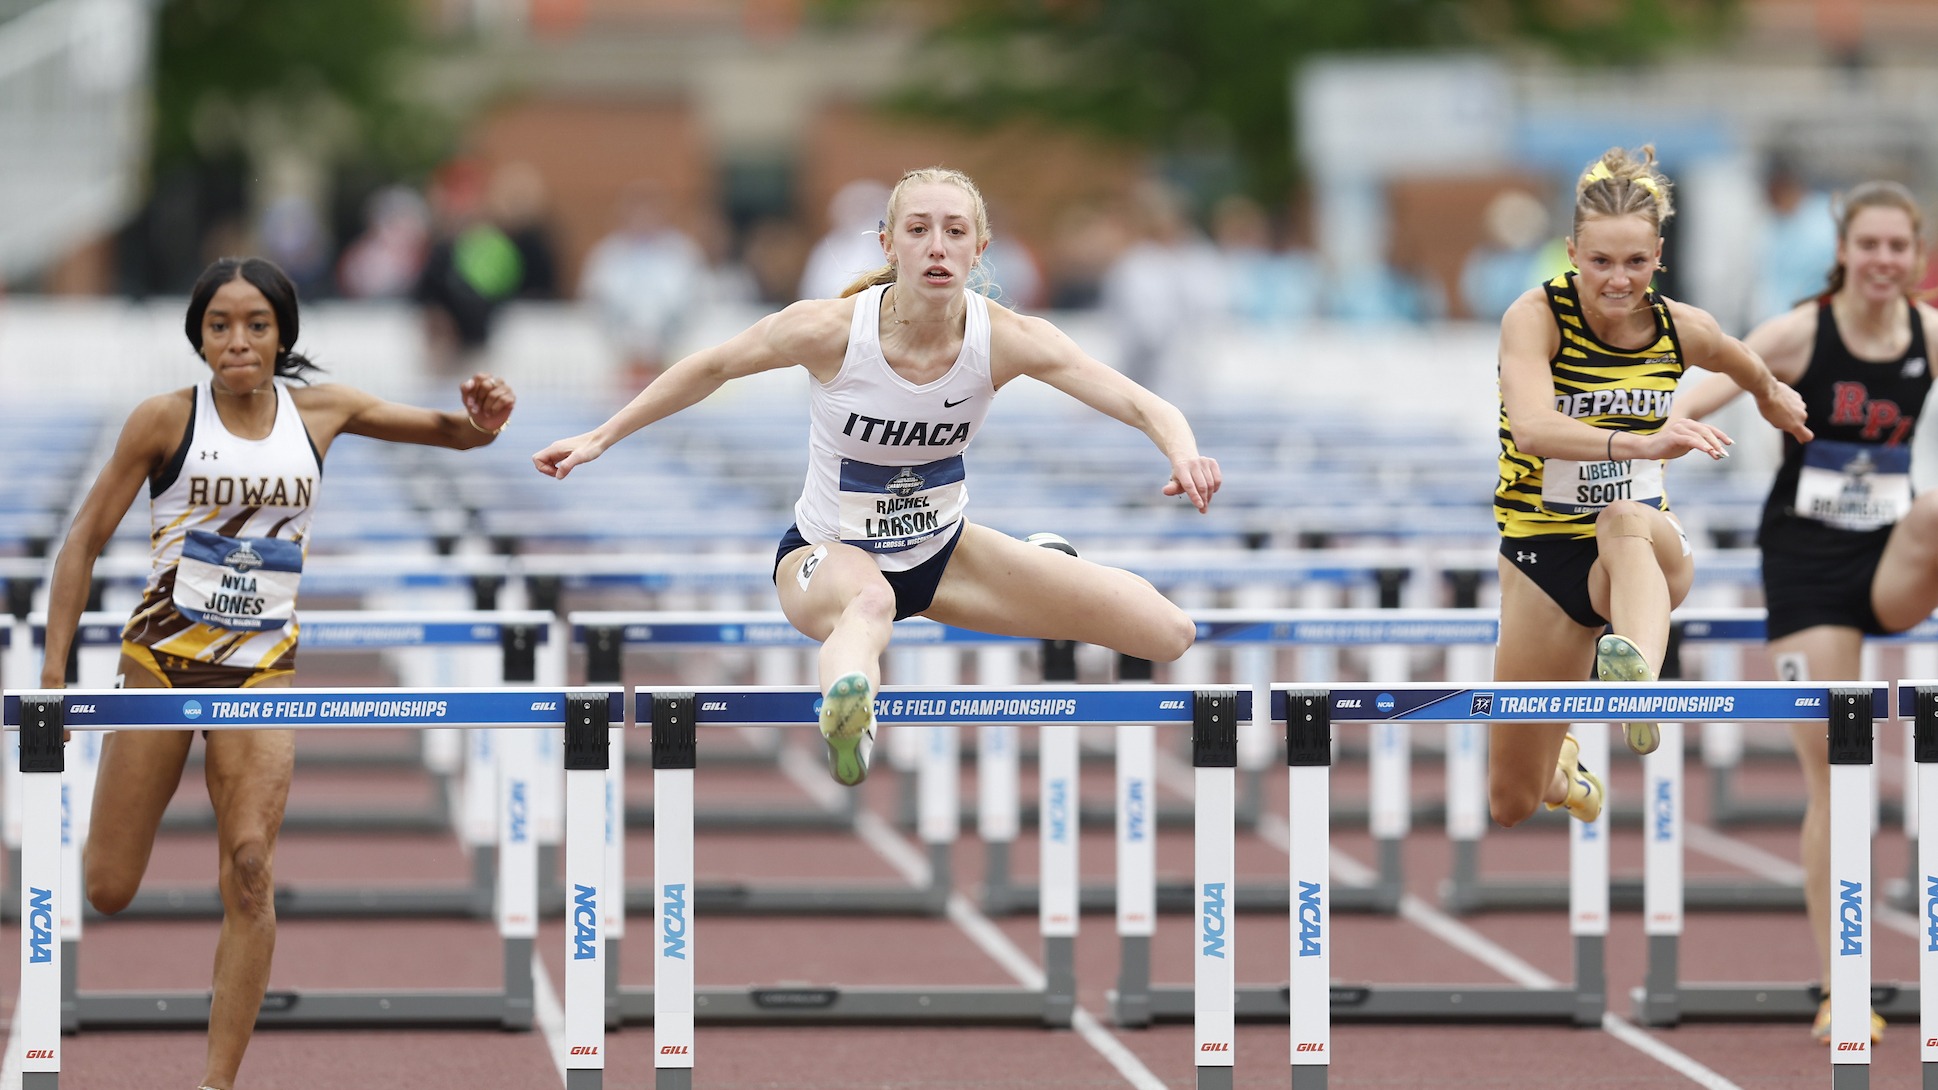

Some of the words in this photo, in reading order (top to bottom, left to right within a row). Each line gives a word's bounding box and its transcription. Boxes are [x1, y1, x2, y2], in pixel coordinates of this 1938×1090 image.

[1554, 388, 1674, 419] DEPAUW
[1829, 381, 1913, 449] RPI
[842, 412, 971, 447] ITHACA
[1578, 460, 1632, 481] LIBERTY
[188, 476, 313, 507] ROWAN
[1576, 479, 1633, 504] SCOTT
[876, 495, 930, 515] RACHEL
[865, 509, 939, 539] LARSON
[874, 541, 882, 549] LA
[221, 574, 257, 593] NYLA
[205, 592, 265, 616] JONES
[69, 704, 96, 713] GILL
[211, 701, 261, 718] TRACK
[262, 701, 274, 718] &
[275, 701, 317, 718] FIELD
[320, 701, 448, 718] CHAMPIONSHIPS
[530, 702, 557, 711] GILL
[701, 702, 728, 711] GILL
[891, 699, 904, 716] &
[905, 699, 947, 716] FIELD
[949, 699, 1077, 716] CHAMPIONSHIPS
[1159, 700, 1186, 709] GILL
[1336, 699, 1363, 708] GILL
[1500, 696, 1550, 713] TRACK
[1550, 696, 1563, 713] &
[1564, 696, 1606, 713] FIELD
[1607, 696, 1735, 713] CHAMPIONSHIPS
[1794, 698, 1821, 707] GILL
[29, 887, 52, 964] NCAA
[574, 884, 597, 960] NCAA
[663, 883, 686, 959] NCAA
[1202, 882, 1226, 959] NCAA
[1299, 880, 1322, 957] NCAA
[1839, 879, 1864, 956] NCAA
[26, 1050, 54, 1059] GILL
[570, 1046, 599, 1055] GILL
[660, 1046, 688, 1055] GILL
[1201, 1043, 1229, 1052] GILL
[1296, 1043, 1324, 1052] GILL
[1837, 1042, 1865, 1051] GILL
